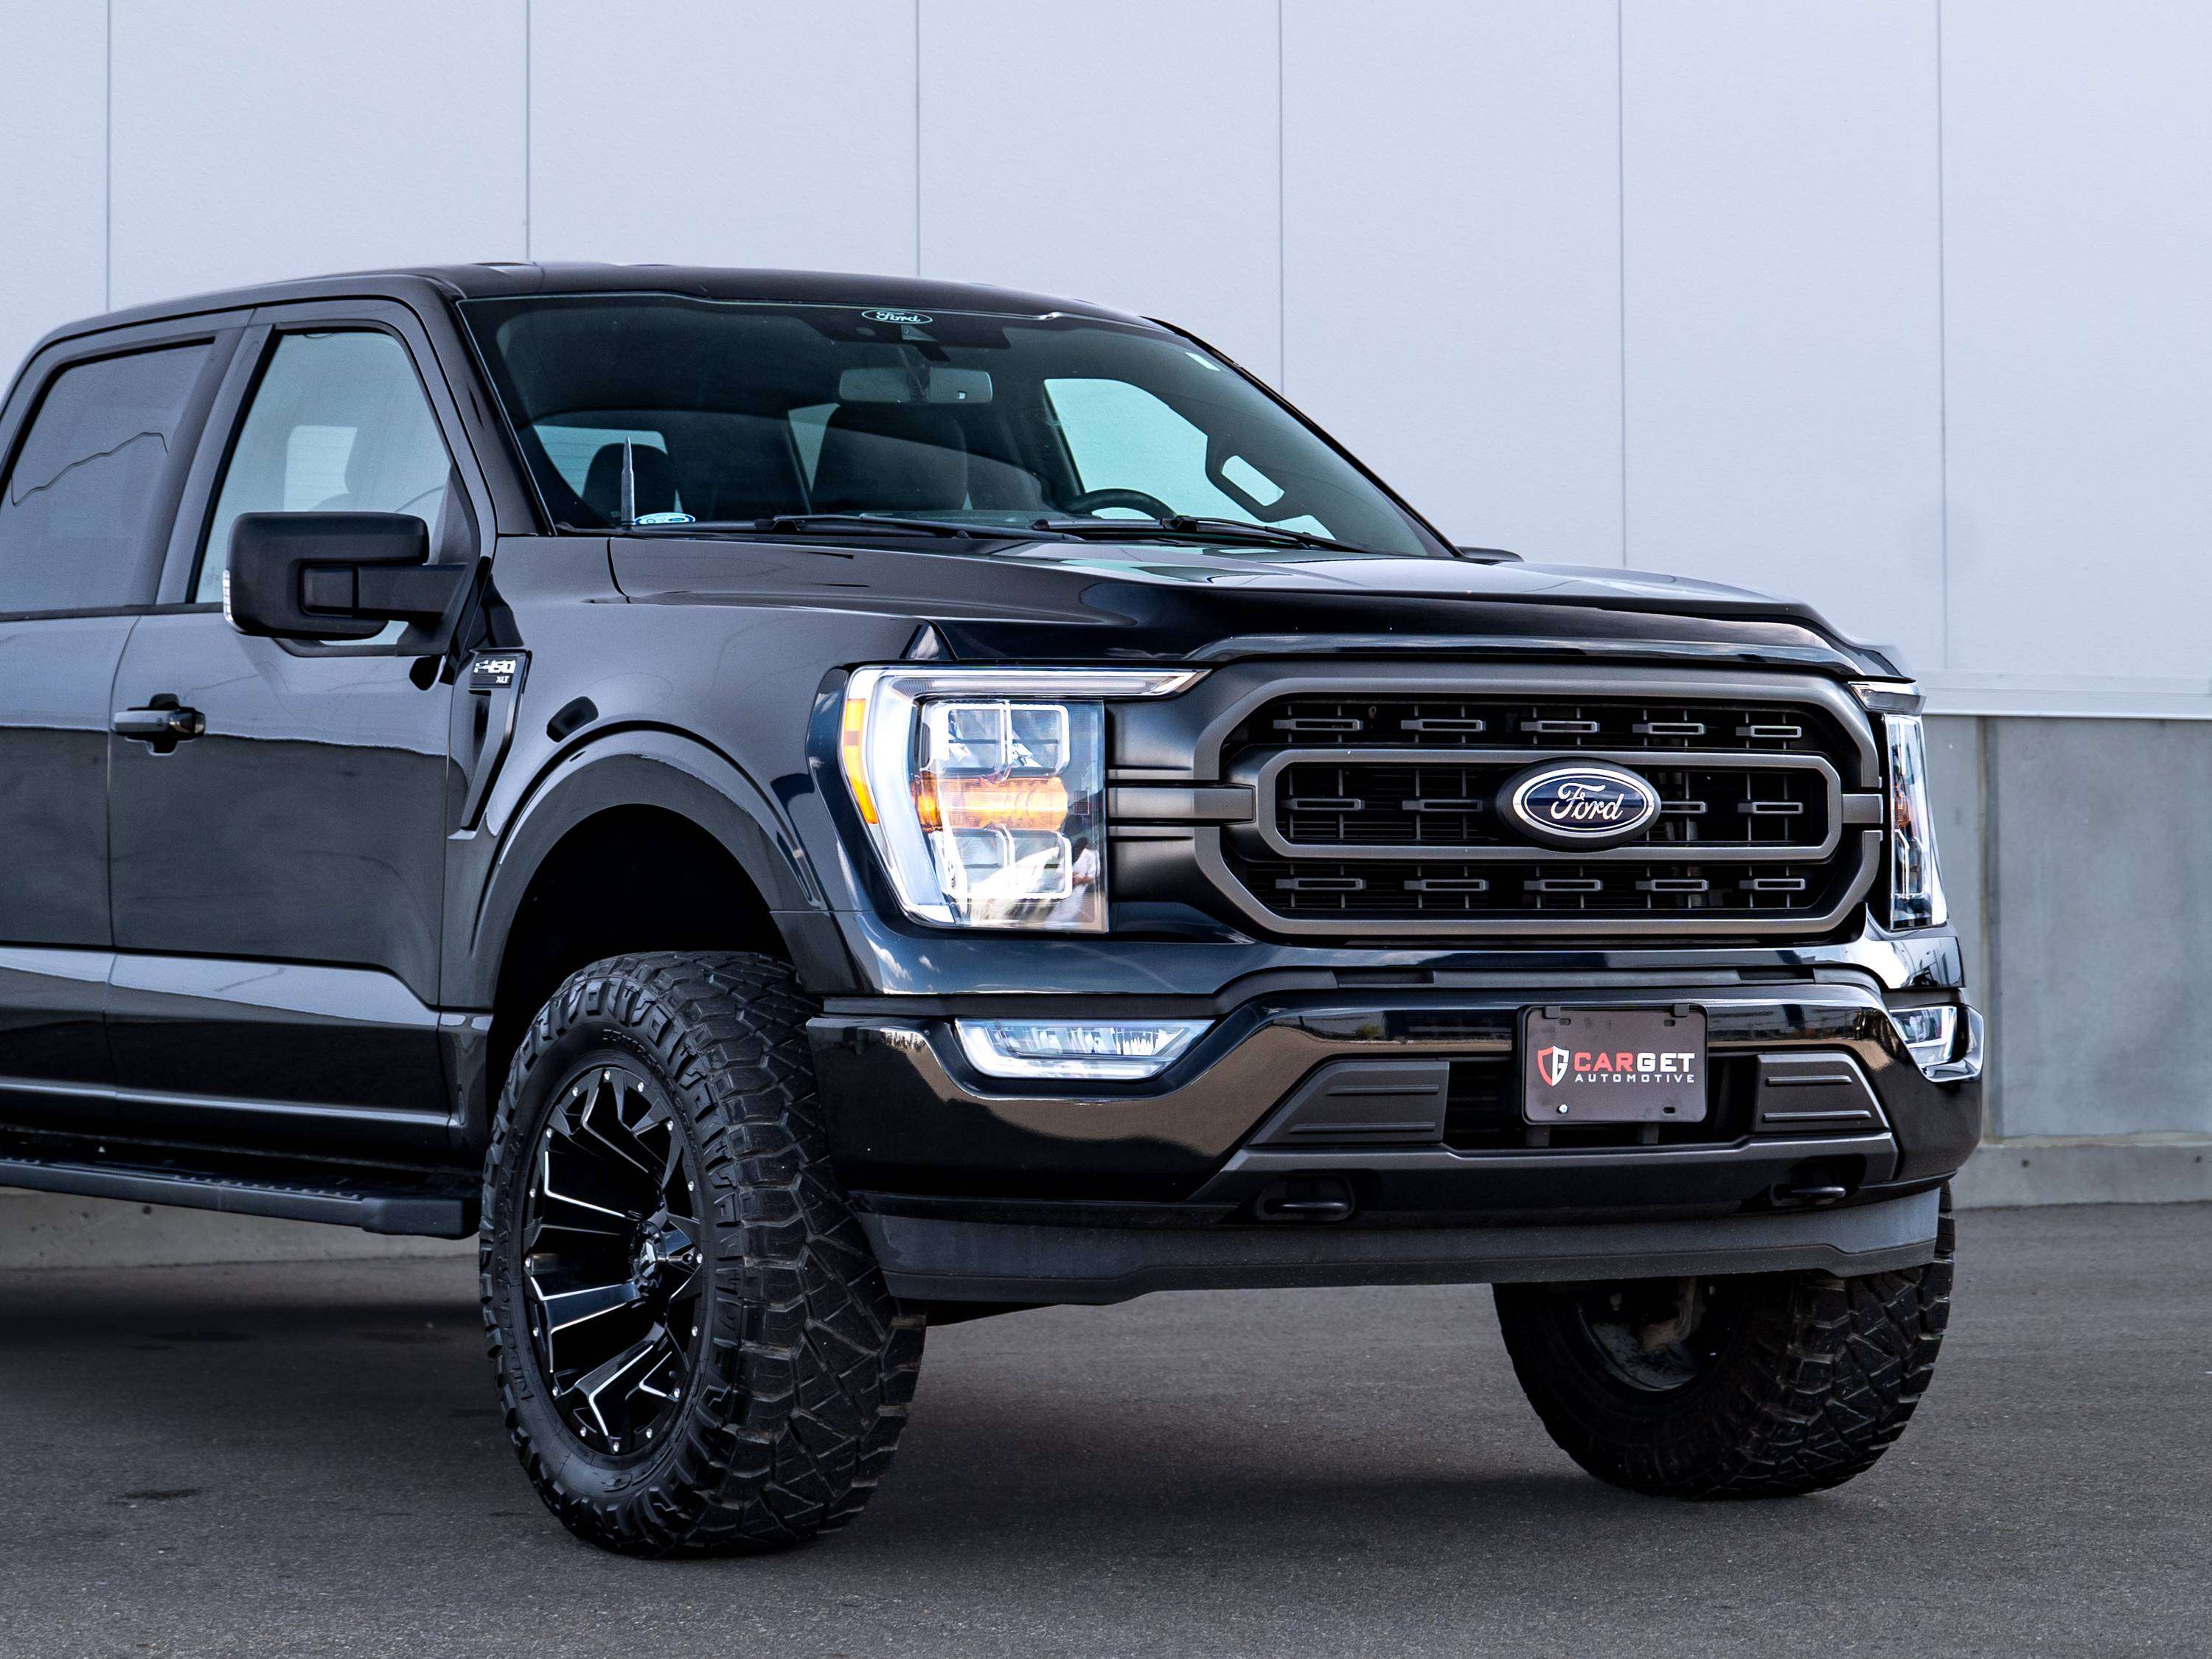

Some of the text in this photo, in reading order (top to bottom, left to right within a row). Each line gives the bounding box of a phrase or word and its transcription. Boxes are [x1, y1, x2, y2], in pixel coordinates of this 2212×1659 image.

[876, 311, 921, 322] Ford
[1550, 782, 1625, 820] Ford
[1574, 1052, 1695, 1072] CARGET
[1575, 1074, 1695, 1083] AUTOMOTIVE
